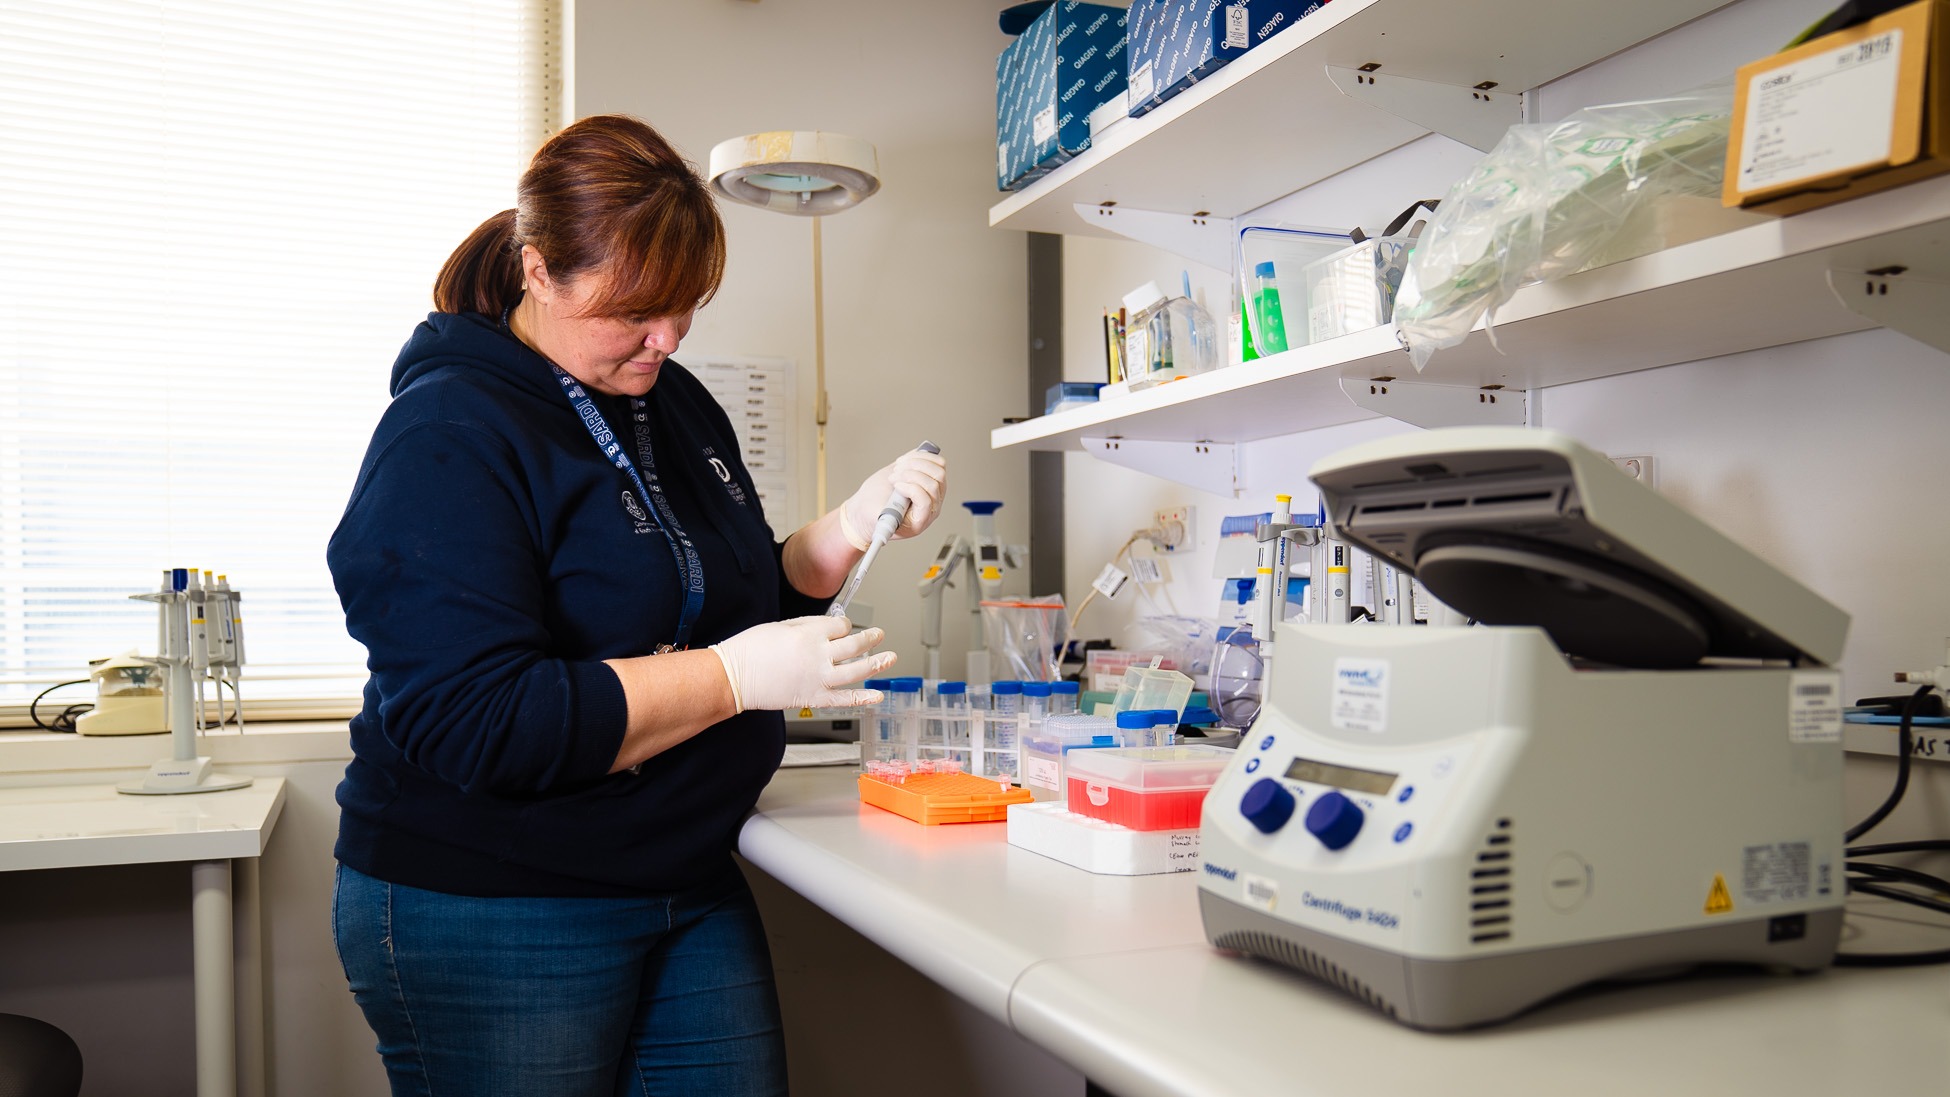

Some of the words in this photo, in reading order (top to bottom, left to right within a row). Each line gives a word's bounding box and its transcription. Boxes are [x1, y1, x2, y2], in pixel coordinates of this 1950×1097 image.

[1085, 13, 1109, 37] QIAGEN
[1134, 4, 1146, 39] QIAGEN
[1170, 4, 1185, 41] QIAGEN
[1203, 0, 1222, 28] QIAGE
[1257, 12, 1284, 40] QIAGEN
[1056, 21, 1078, 46] IAGEN
[1143, 18, 1156, 54] QIAGEN
[1183, 20, 1198, 58] QIAGEN
[1073, 45, 1098, 70] QIAGEN
[1154, 33, 1167, 70] QIAGEN
[1166, 49, 1180, 86] QIAGEN
[1061, 78, 1086, 103] QIAGEN
[1094, 68, 1118, 93] QIAGEN
[576, 399, 613, 446] SARDI
[634, 424, 655, 468] SARDI
[684, 548, 704, 593] SARDI
